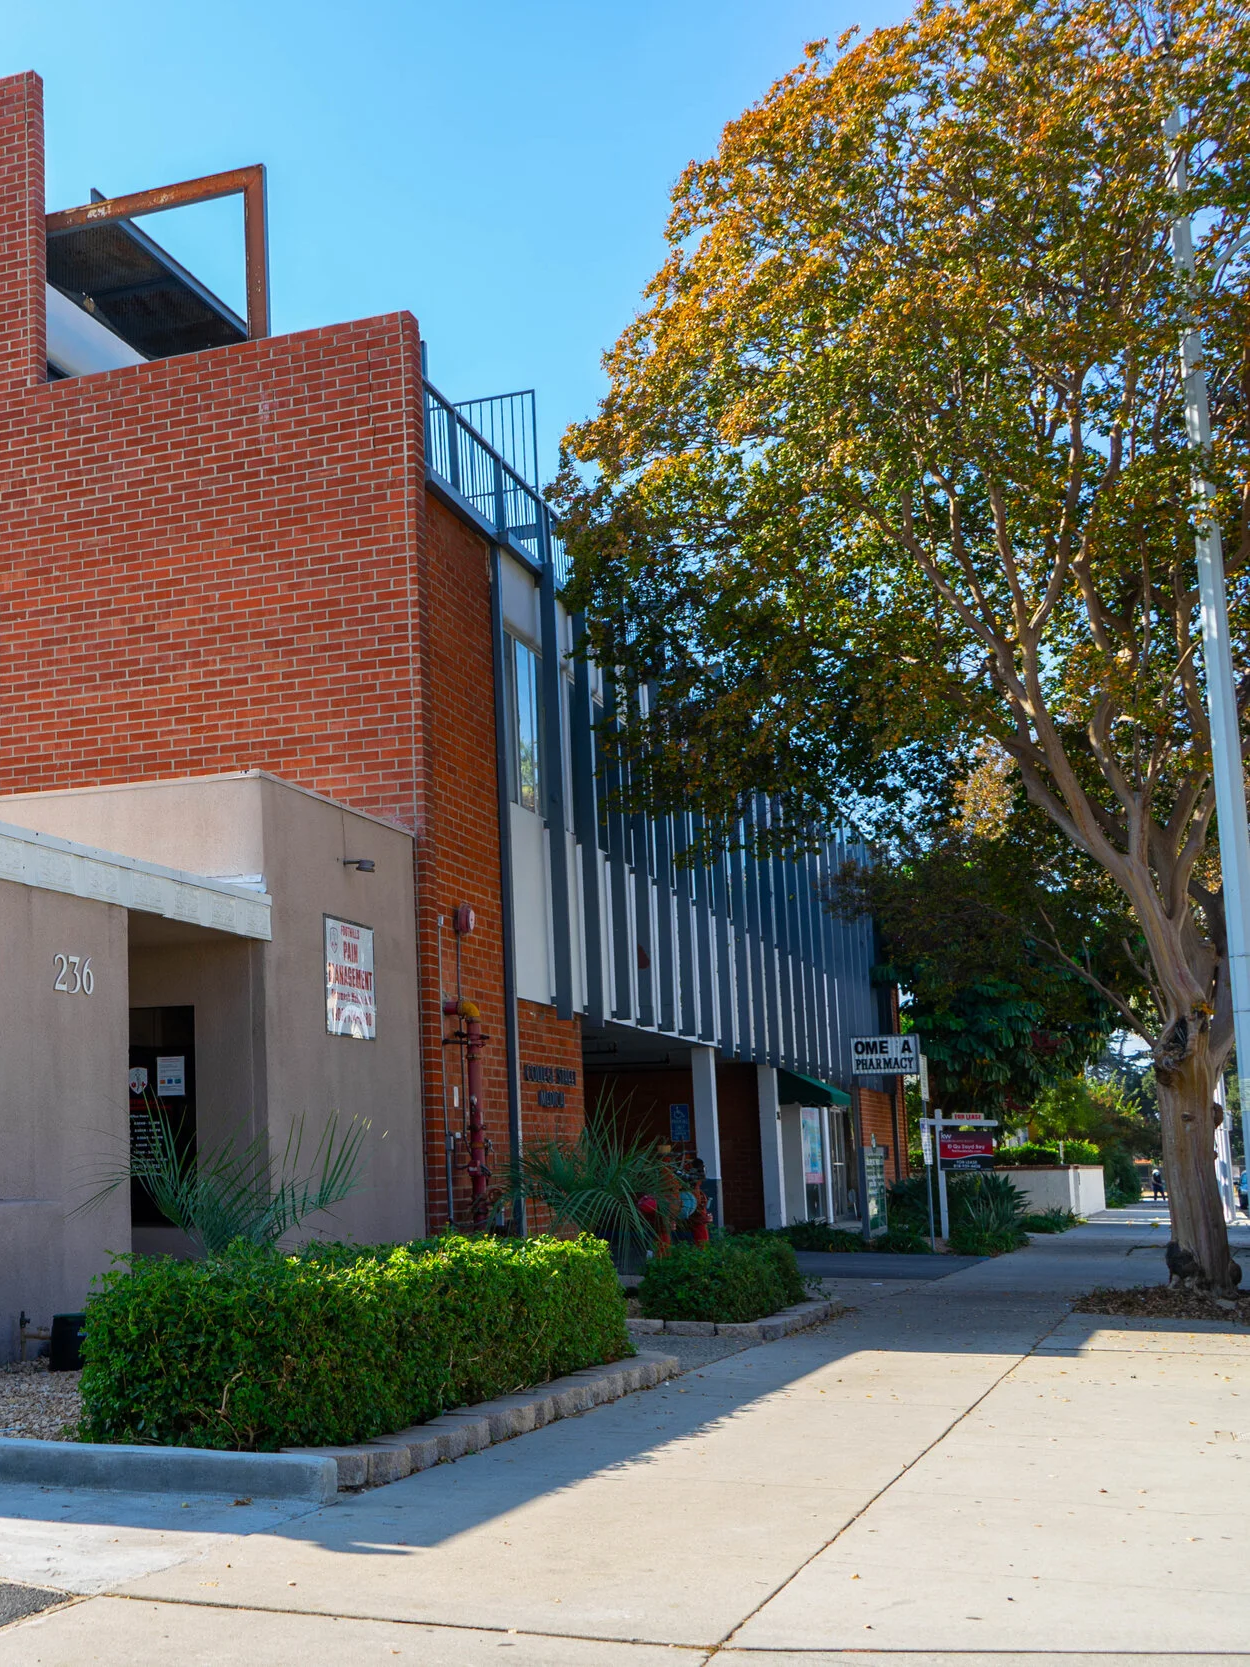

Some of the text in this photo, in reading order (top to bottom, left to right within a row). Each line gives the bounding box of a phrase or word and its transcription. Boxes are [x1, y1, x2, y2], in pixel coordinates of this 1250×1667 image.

[343, 940, 359, 965] PAIN
[53, 953, 94, 995] 236
[854, 1039, 913, 1055] OME A
[855, 1057, 914, 1070] PHARMACY
